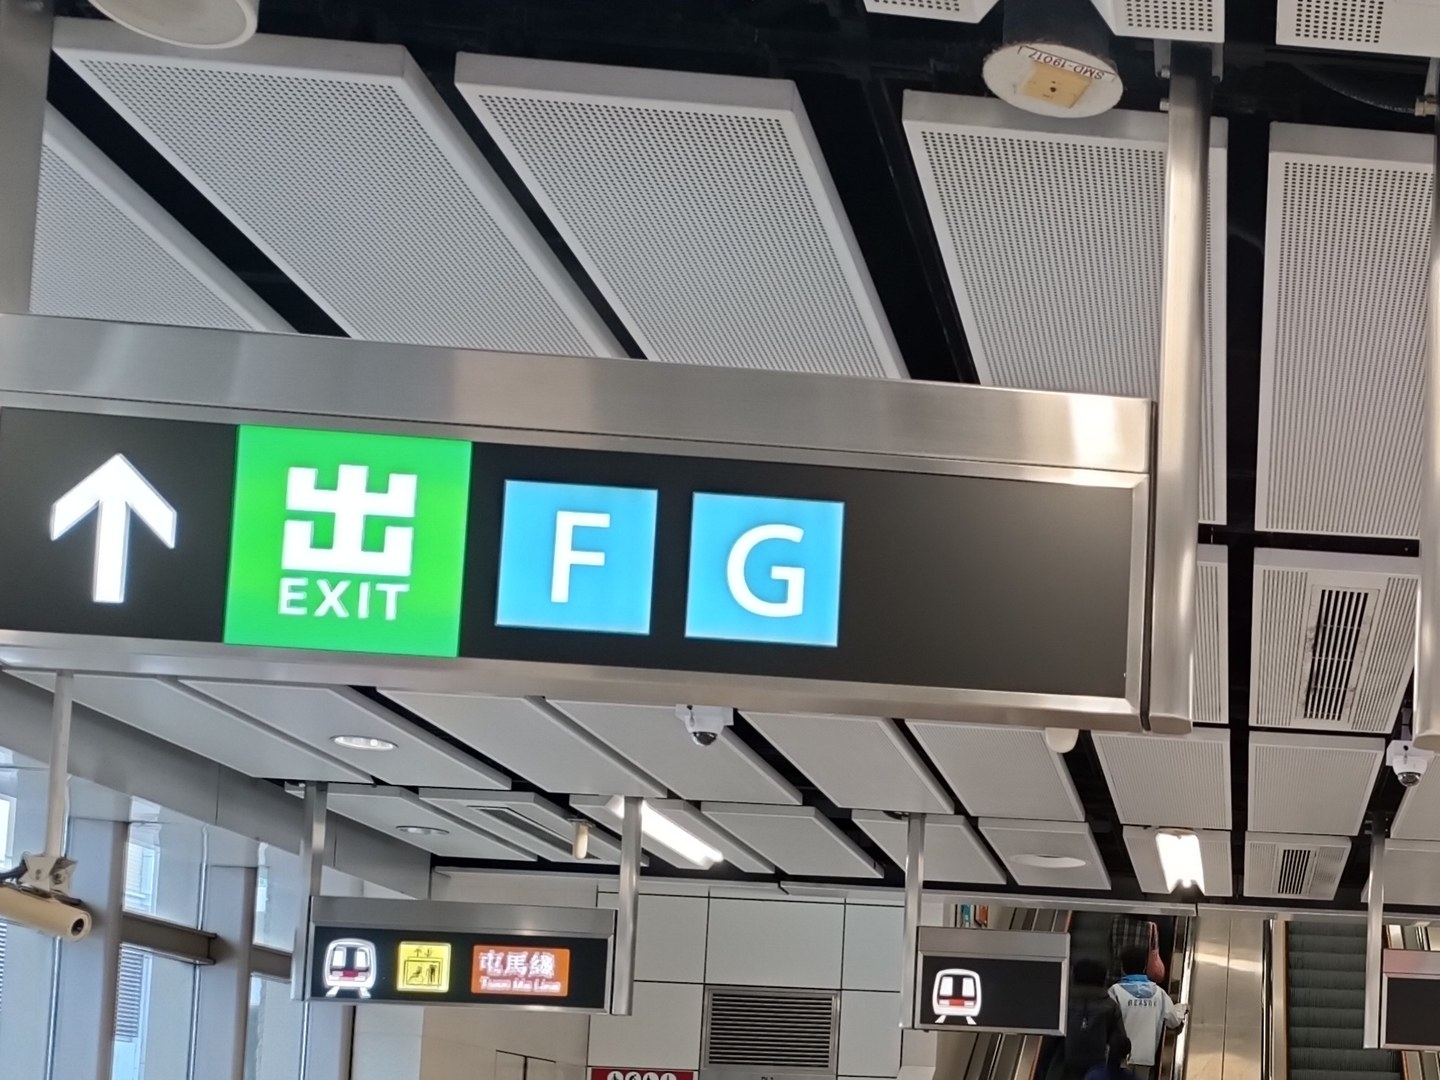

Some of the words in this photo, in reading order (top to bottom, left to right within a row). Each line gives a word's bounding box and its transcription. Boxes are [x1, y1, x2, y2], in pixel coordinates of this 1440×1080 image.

[1028, 51, 1104, 80] SMD-19017
[281, 464, 417, 577] 出
[551, 510, 611, 603] F
[278, 577, 410, 621] EXIT
[726, 523, 805, 618] G
